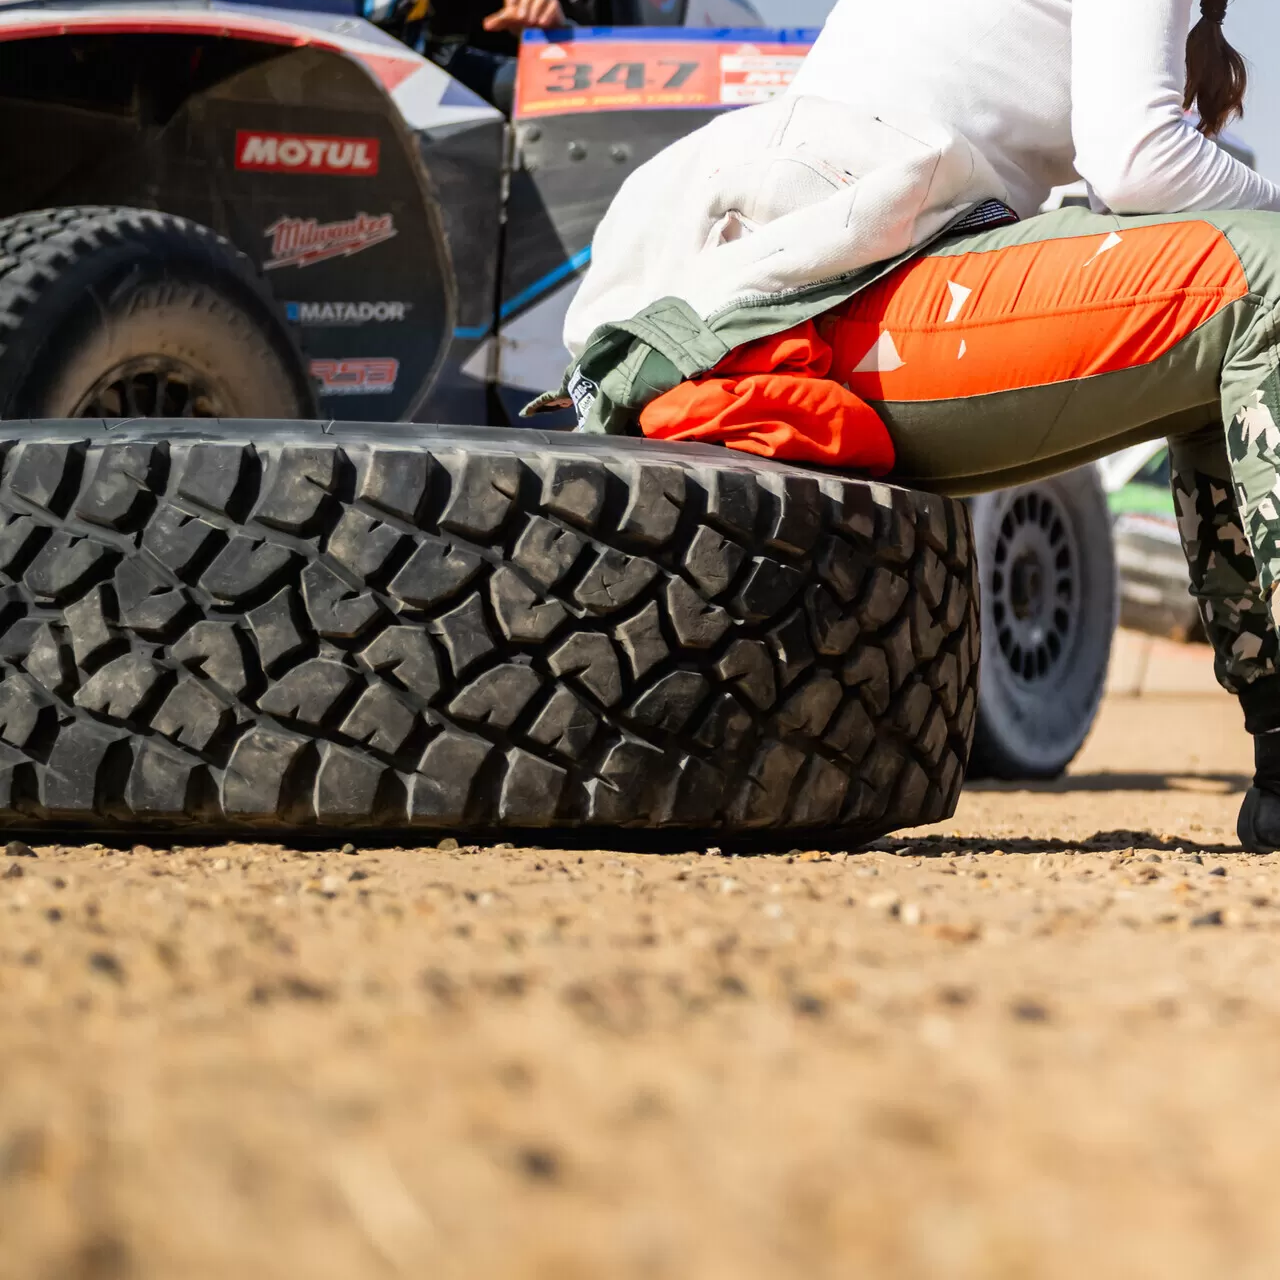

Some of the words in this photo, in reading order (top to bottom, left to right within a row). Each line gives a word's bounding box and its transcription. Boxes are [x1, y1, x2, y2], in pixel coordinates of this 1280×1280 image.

[546, 60, 699, 91] 347
[241, 136, 372, 168] MOTUL
[264, 212, 394, 261] Milwaukee
[301, 302, 405, 321] MATADOR
